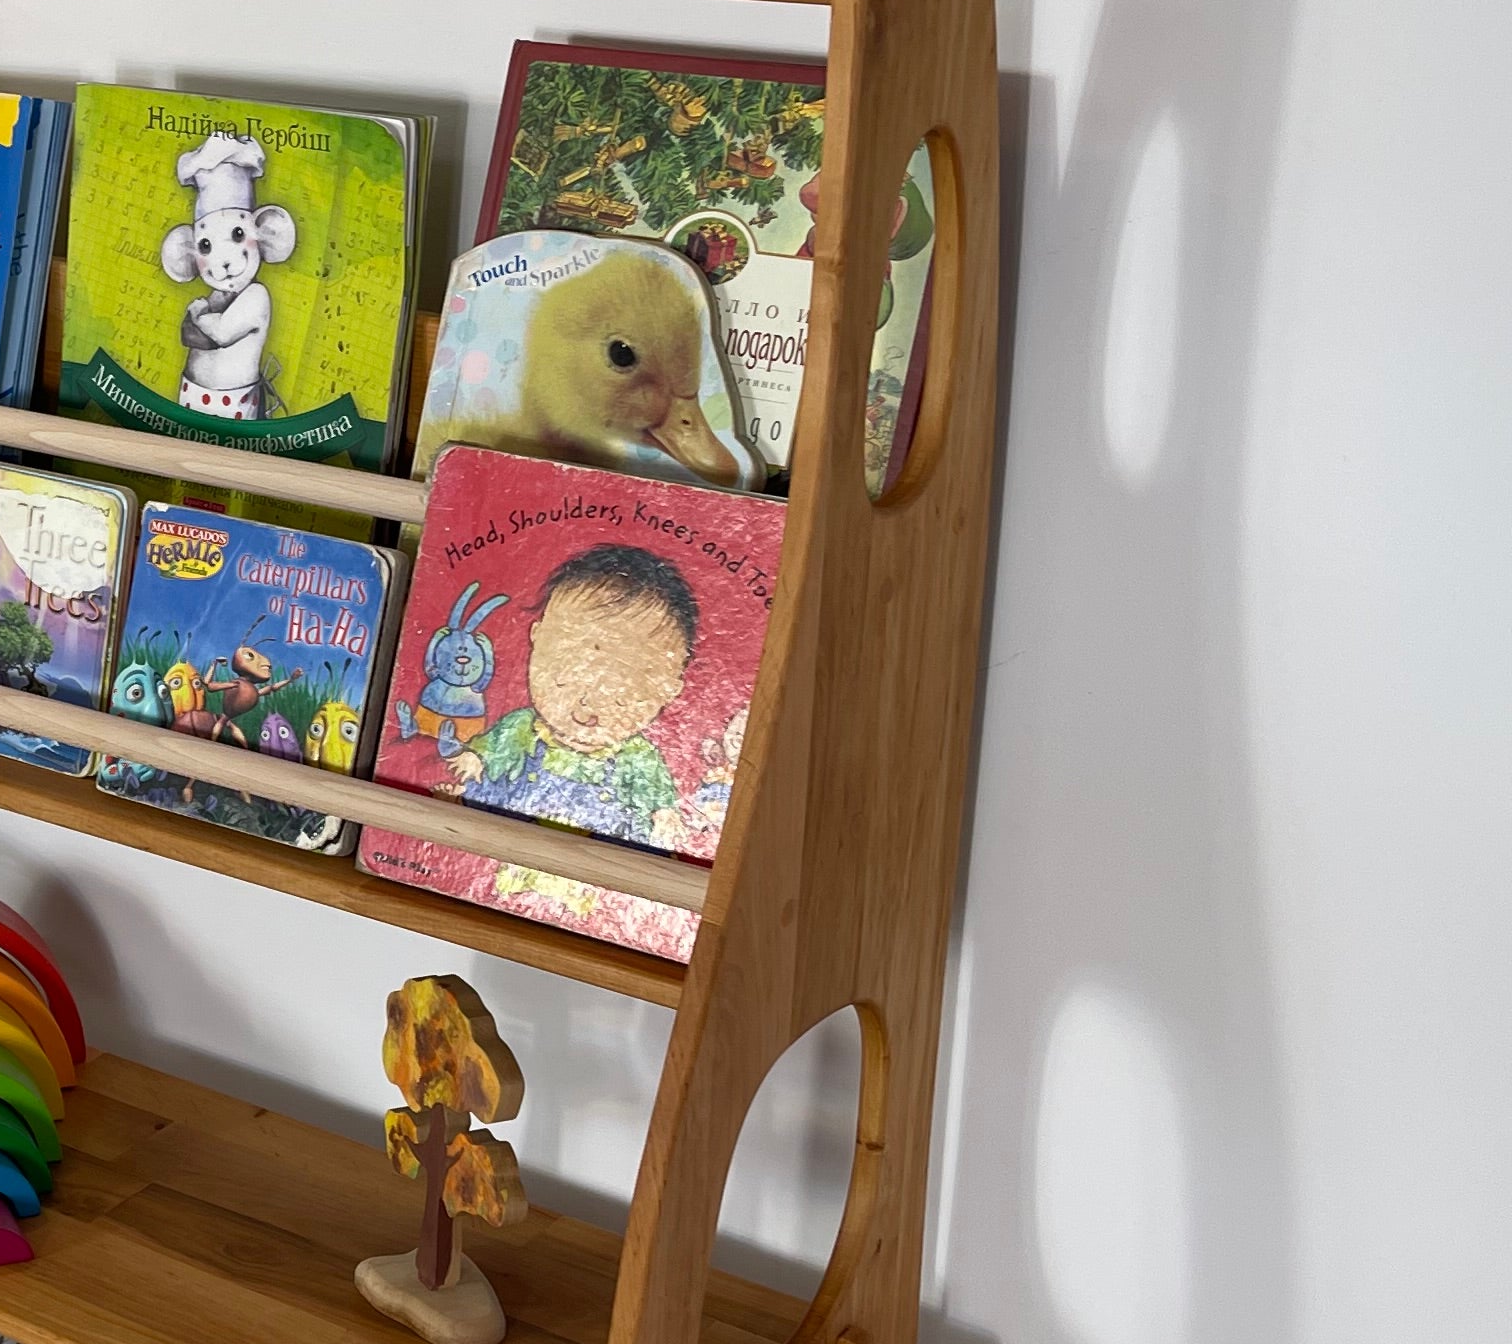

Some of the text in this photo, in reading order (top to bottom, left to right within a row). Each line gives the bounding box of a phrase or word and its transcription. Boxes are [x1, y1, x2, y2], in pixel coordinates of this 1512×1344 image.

[146, 106, 237, 140] Надійка
[244, 117, 331, 153] Гербіш
[468, 255, 528, 287] Touch
[505, 248, 600, 288] and Sparkle
[717, 297, 780, 319] ЛЛО
[91, 364, 220, 446] Мишеняткова
[18, 502, 107, 568] Three
[151, 521, 227, 544] MAX LUCADO'S
[279, 533, 306, 557] The
[444, 520, 506, 569] Head,
[508, 496, 623, 536] Shoulders,
[633, 500, 699, 545] Knees
[702, 540, 749, 574] and
[237, 554, 368, 605] Caterpillars
[269, 595, 287, 615] of
[286, 603, 370, 657] Ha-Ha
